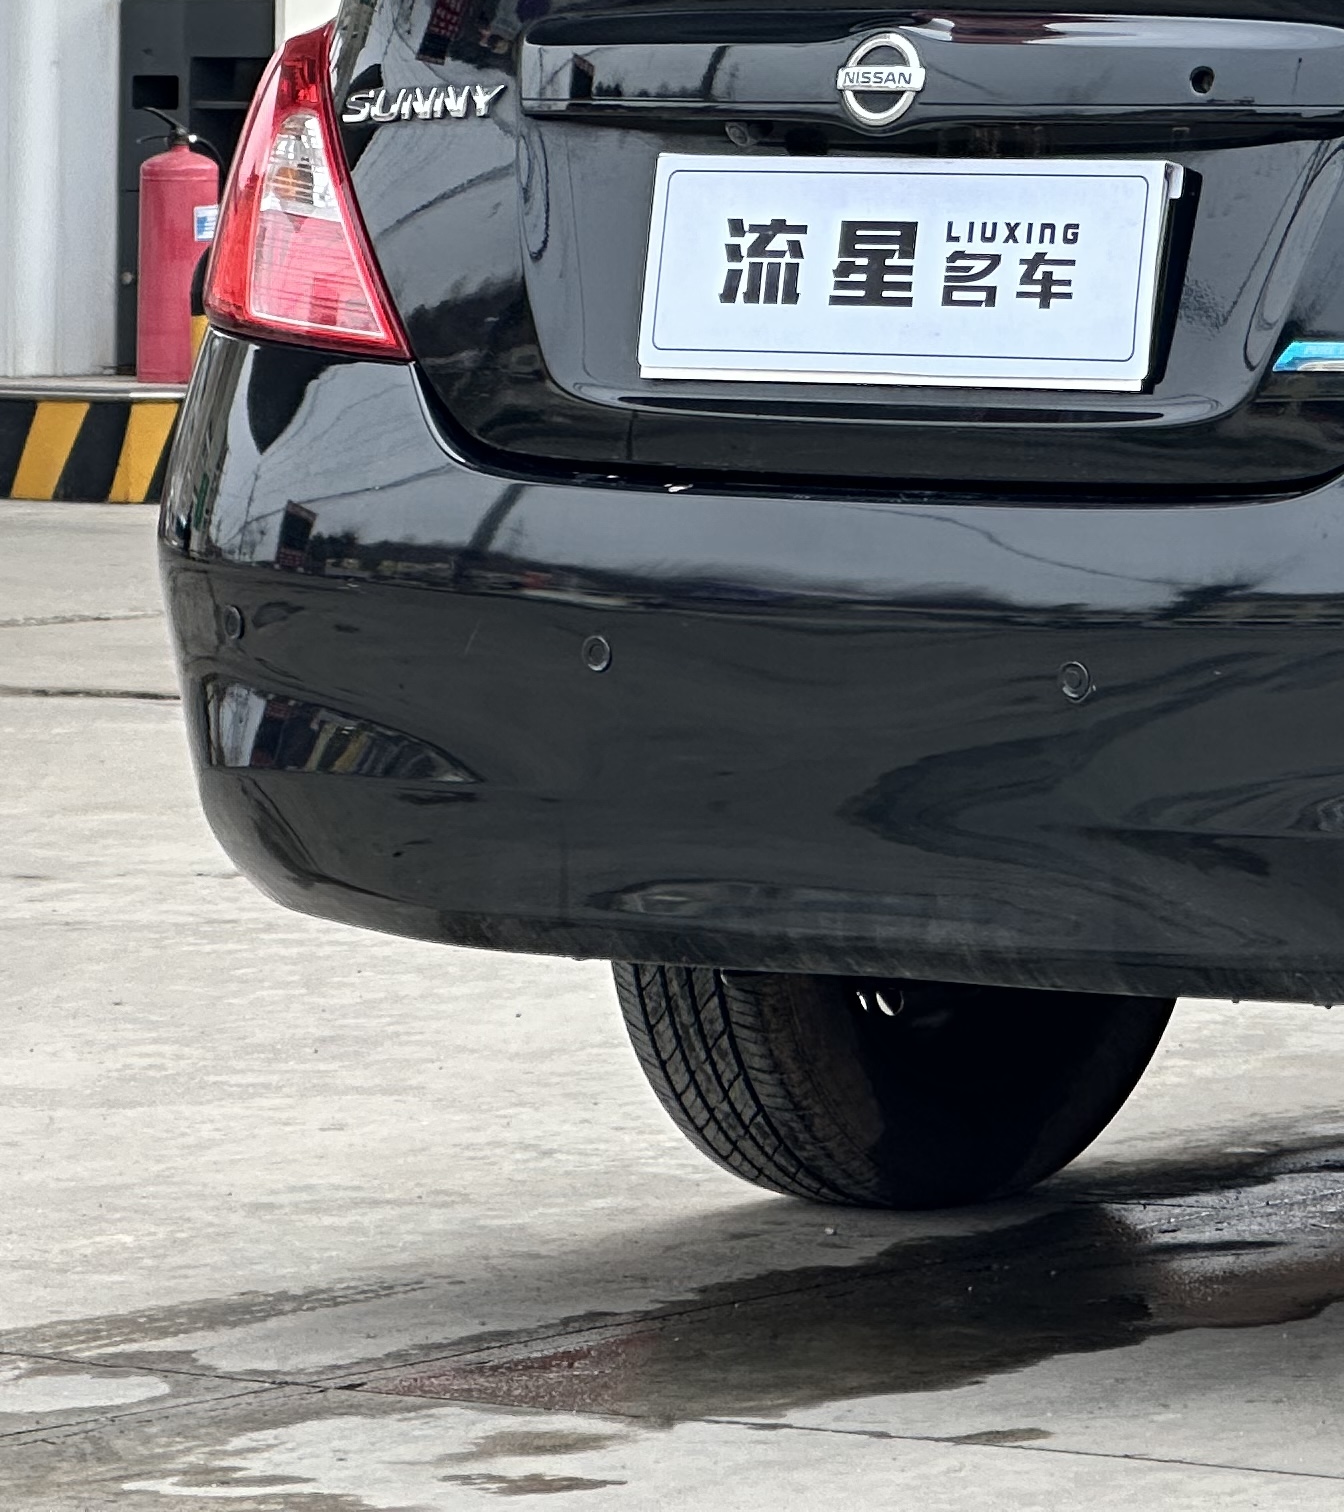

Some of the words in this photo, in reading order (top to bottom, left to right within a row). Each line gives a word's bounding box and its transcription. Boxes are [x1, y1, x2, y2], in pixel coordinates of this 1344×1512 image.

[843, 71, 912, 85] NISSAN
[342, 84, 506, 123] SUNNY
[945, 220, 1080, 245] LIUXING
[718, 218, 919, 308] 流星
[941, 250, 1077, 310] 名车
